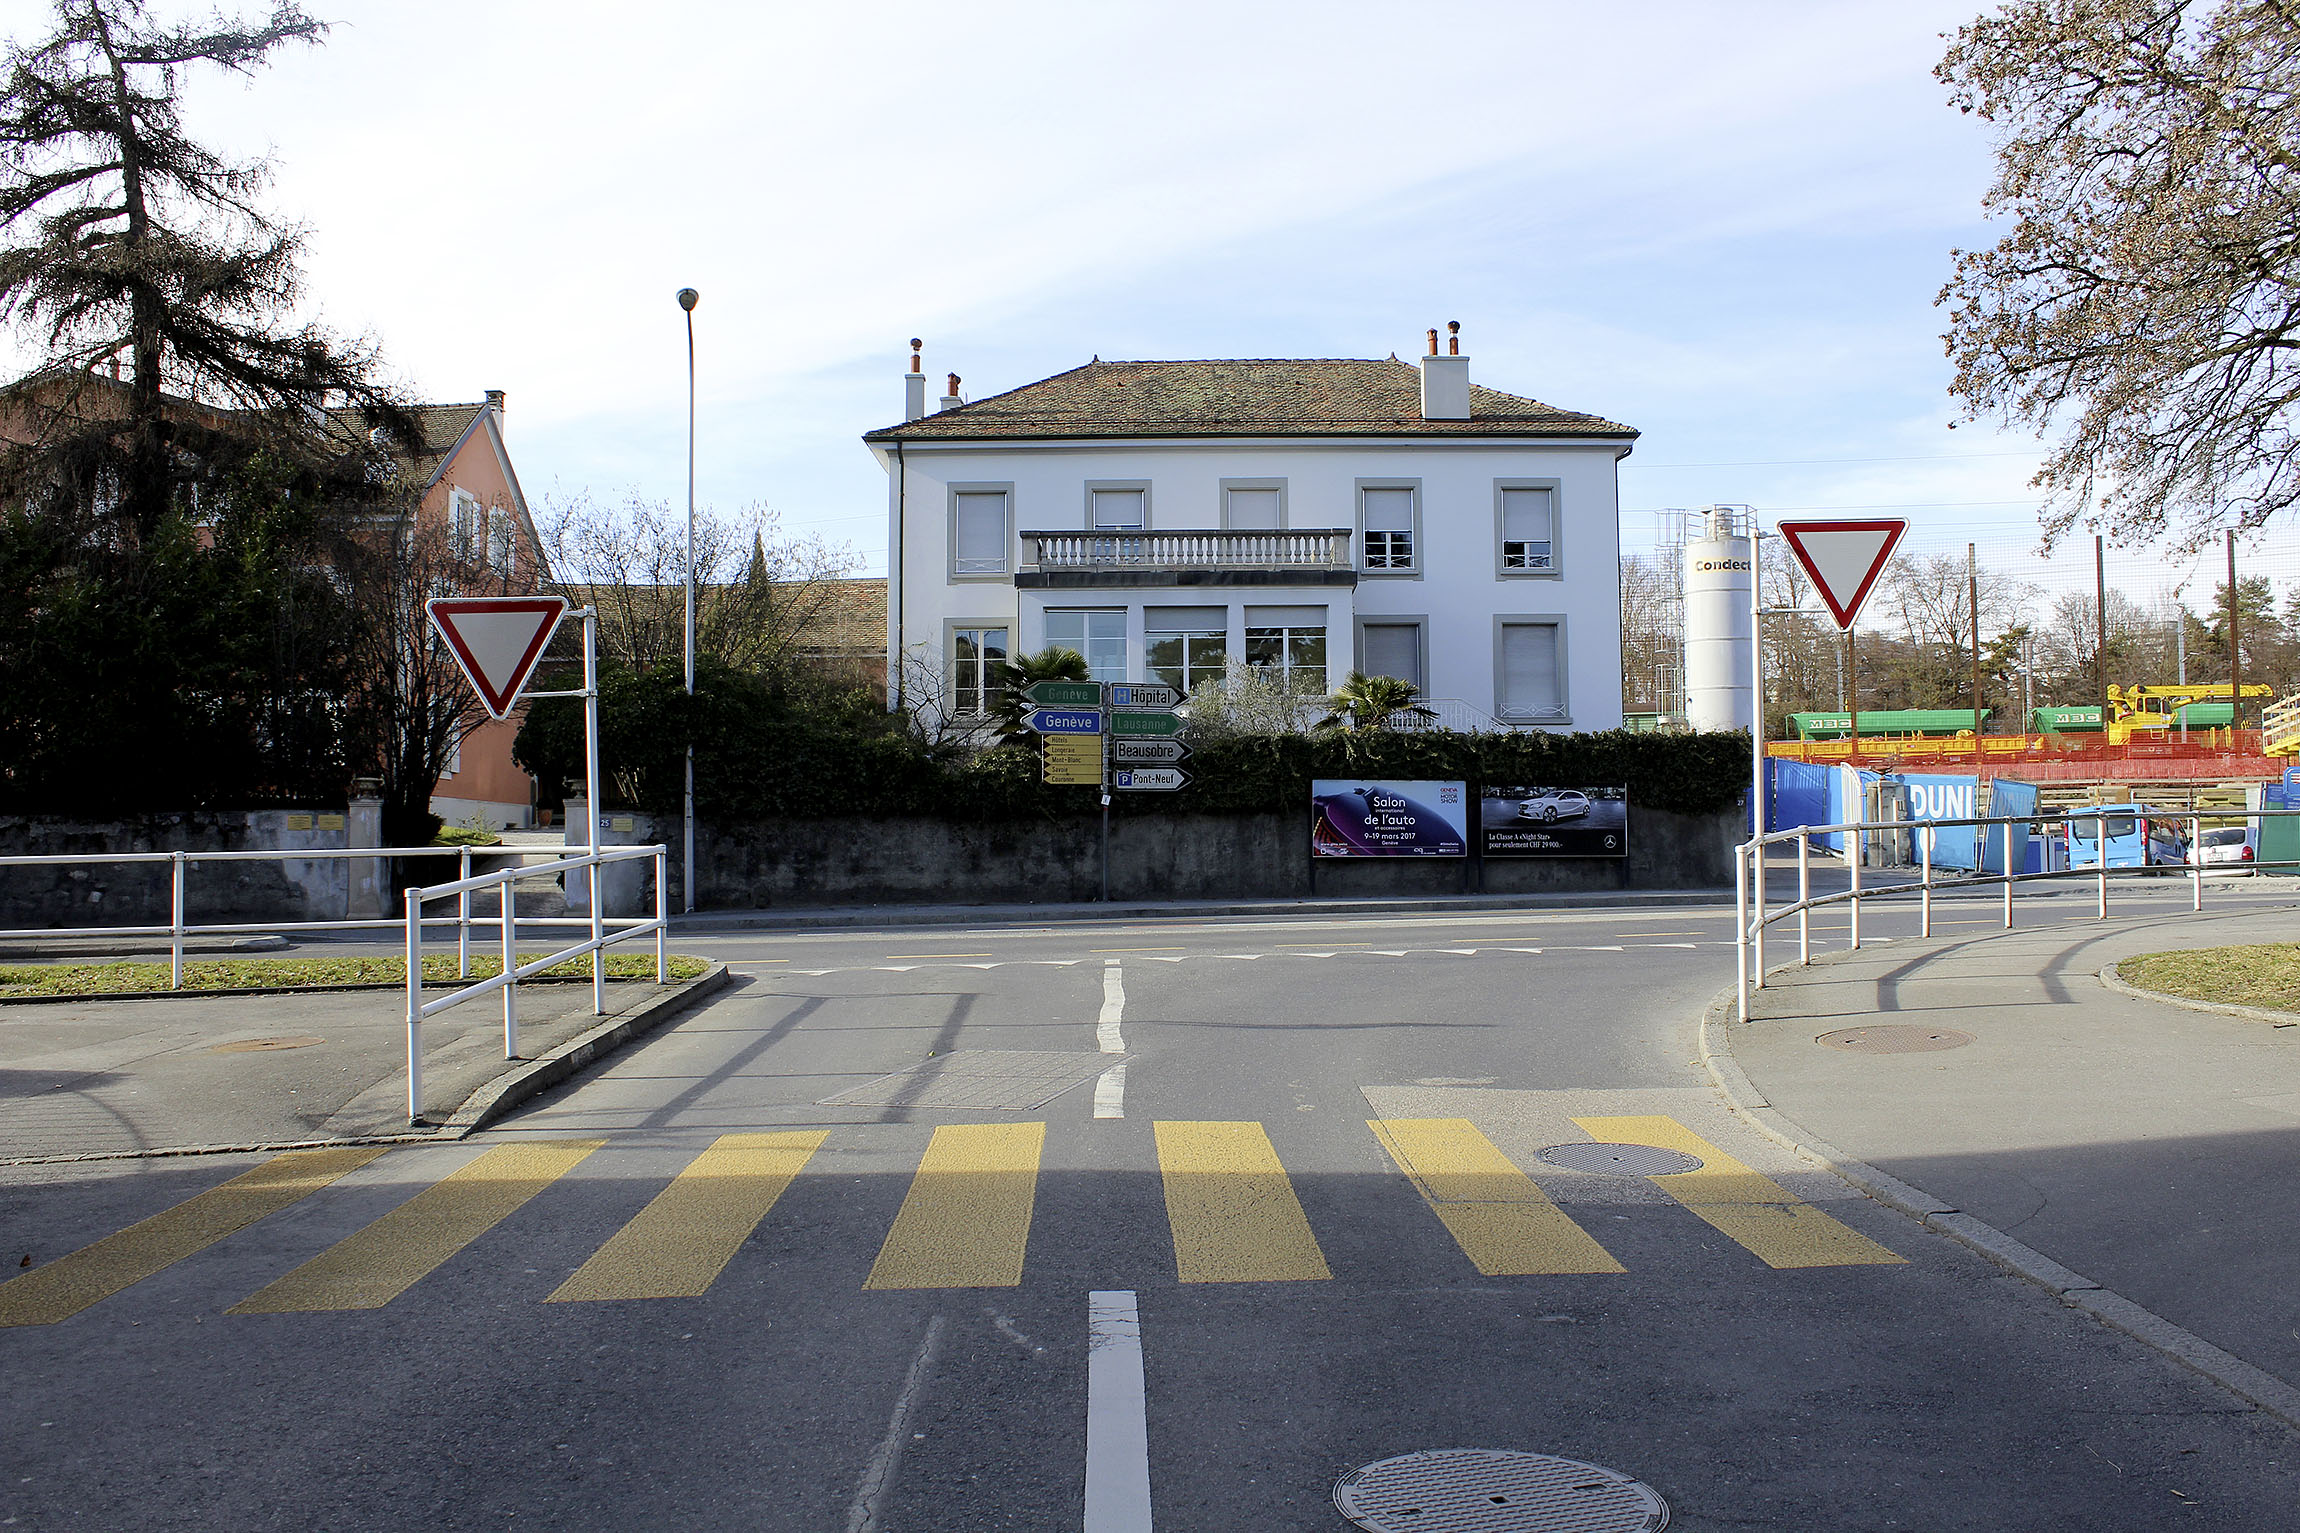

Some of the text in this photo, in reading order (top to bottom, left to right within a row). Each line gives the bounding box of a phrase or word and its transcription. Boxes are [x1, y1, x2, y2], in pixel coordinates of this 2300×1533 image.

[1048, 688, 1089, 701] Genève
[1117, 689, 1171, 706] H Hôpital
[1045, 714, 1093, 728] Genève
[1117, 717, 1167, 730] Lausanne
[1118, 743, 1174, 757] Beausobre
[1133, 773, 1175, 784] Pont-Neuf
[1373, 796, 1406, 808] Salon
[1910, 784, 1973, 818] DUNI
[600, 819, 610, 827] 25
[1364, 814, 1416, 825] de l'auto
[1364, 832, 1380, 840] 9-19
[1400, 832, 1416, 840] 2017
[1488, 842, 1502, 850] pour
